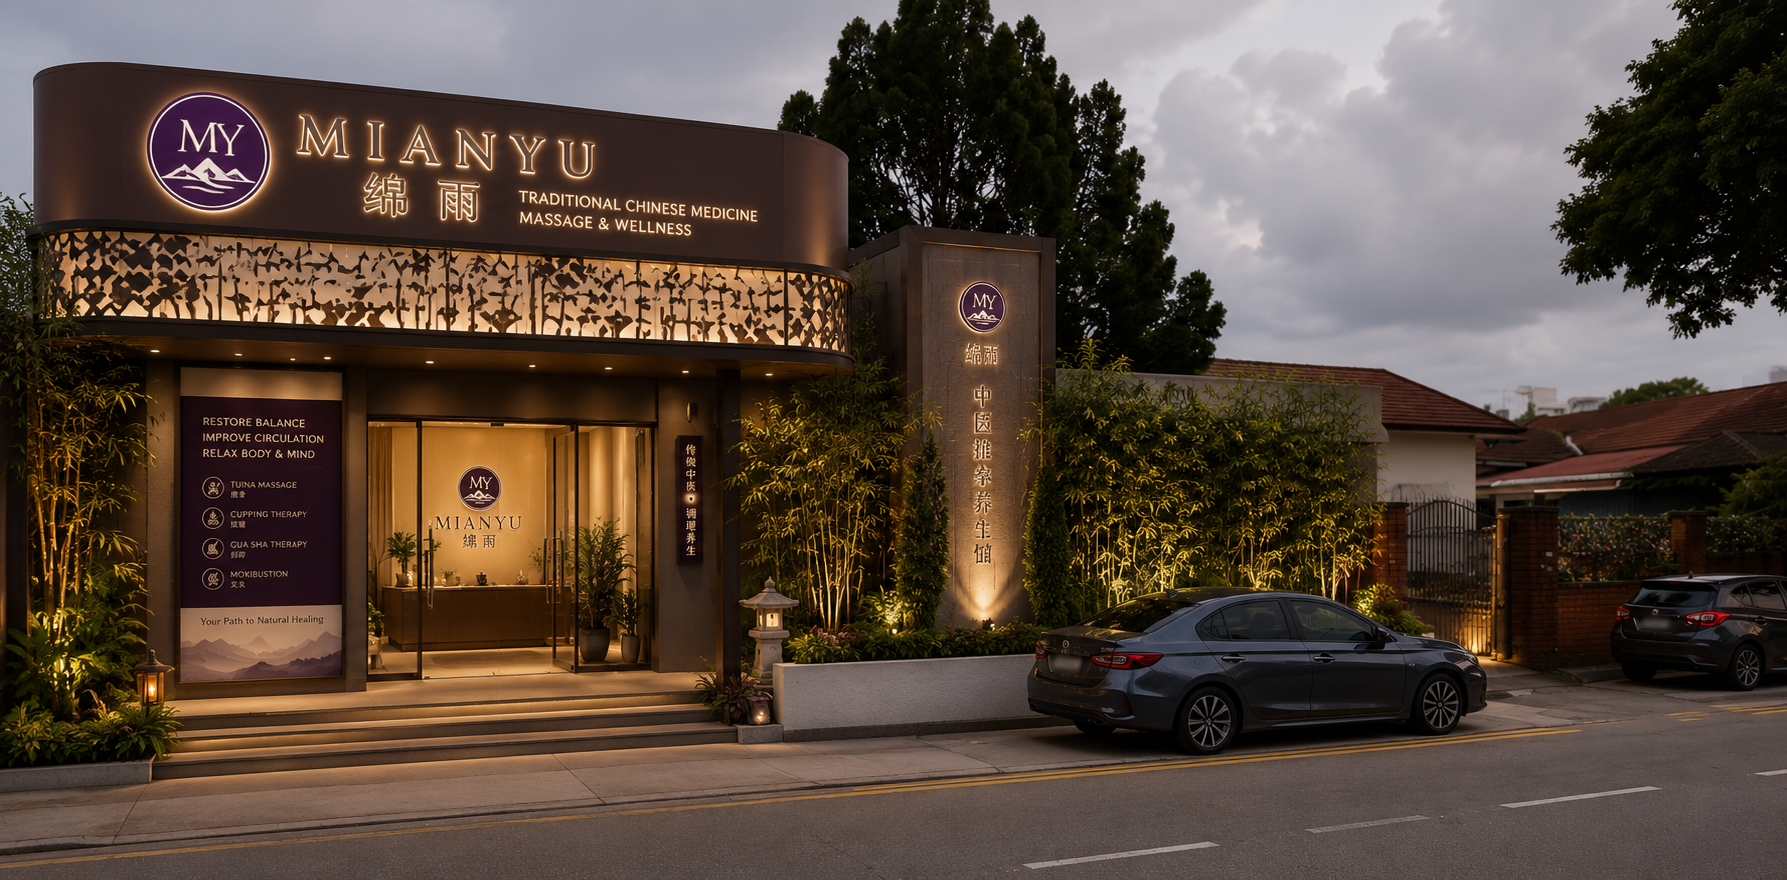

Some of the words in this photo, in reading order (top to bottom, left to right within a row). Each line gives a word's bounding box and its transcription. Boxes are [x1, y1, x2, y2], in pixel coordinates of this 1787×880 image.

[178, 119, 244, 156] MY
[296, 114, 596, 179] MIANYU
[363, 171, 481, 223] 绵雨
[519, 190, 621, 212] TRADITIONAL
[625, 199, 686, 216] CHINESE
[691, 205, 758, 223] MEDICINE
[519, 211, 593, 229] MASSAGE
[598, 217, 609, 230] &
[615, 218, 692, 236] WELLNESS
[972, 292, 997, 310] MY
[202, 417, 252, 427] RESTORE
[255, 418, 306, 428] BALANCE
[202, 433, 251, 443] IMPROVE
[254, 434, 324, 444] CIRCULATION
[202, 449, 238, 458] RELAX
[241, 449, 272, 458] BODY
[275, 450, 283, 459] &
[287, 450, 315, 459] MIND
[230, 480, 256, 489] TUINA
[258, 481, 297, 489] MASSAGE
[469, 475, 493, 490] MY
[230, 510, 268, 518] CUPPING
[435, 516, 522, 531] MIANYU
[200, 617, 221, 626] Your
[223, 617, 243, 625] Path
[246, 617, 254, 625] to
[257, 616, 289, 624] Natural
[291, 615, 324, 625] Healing
